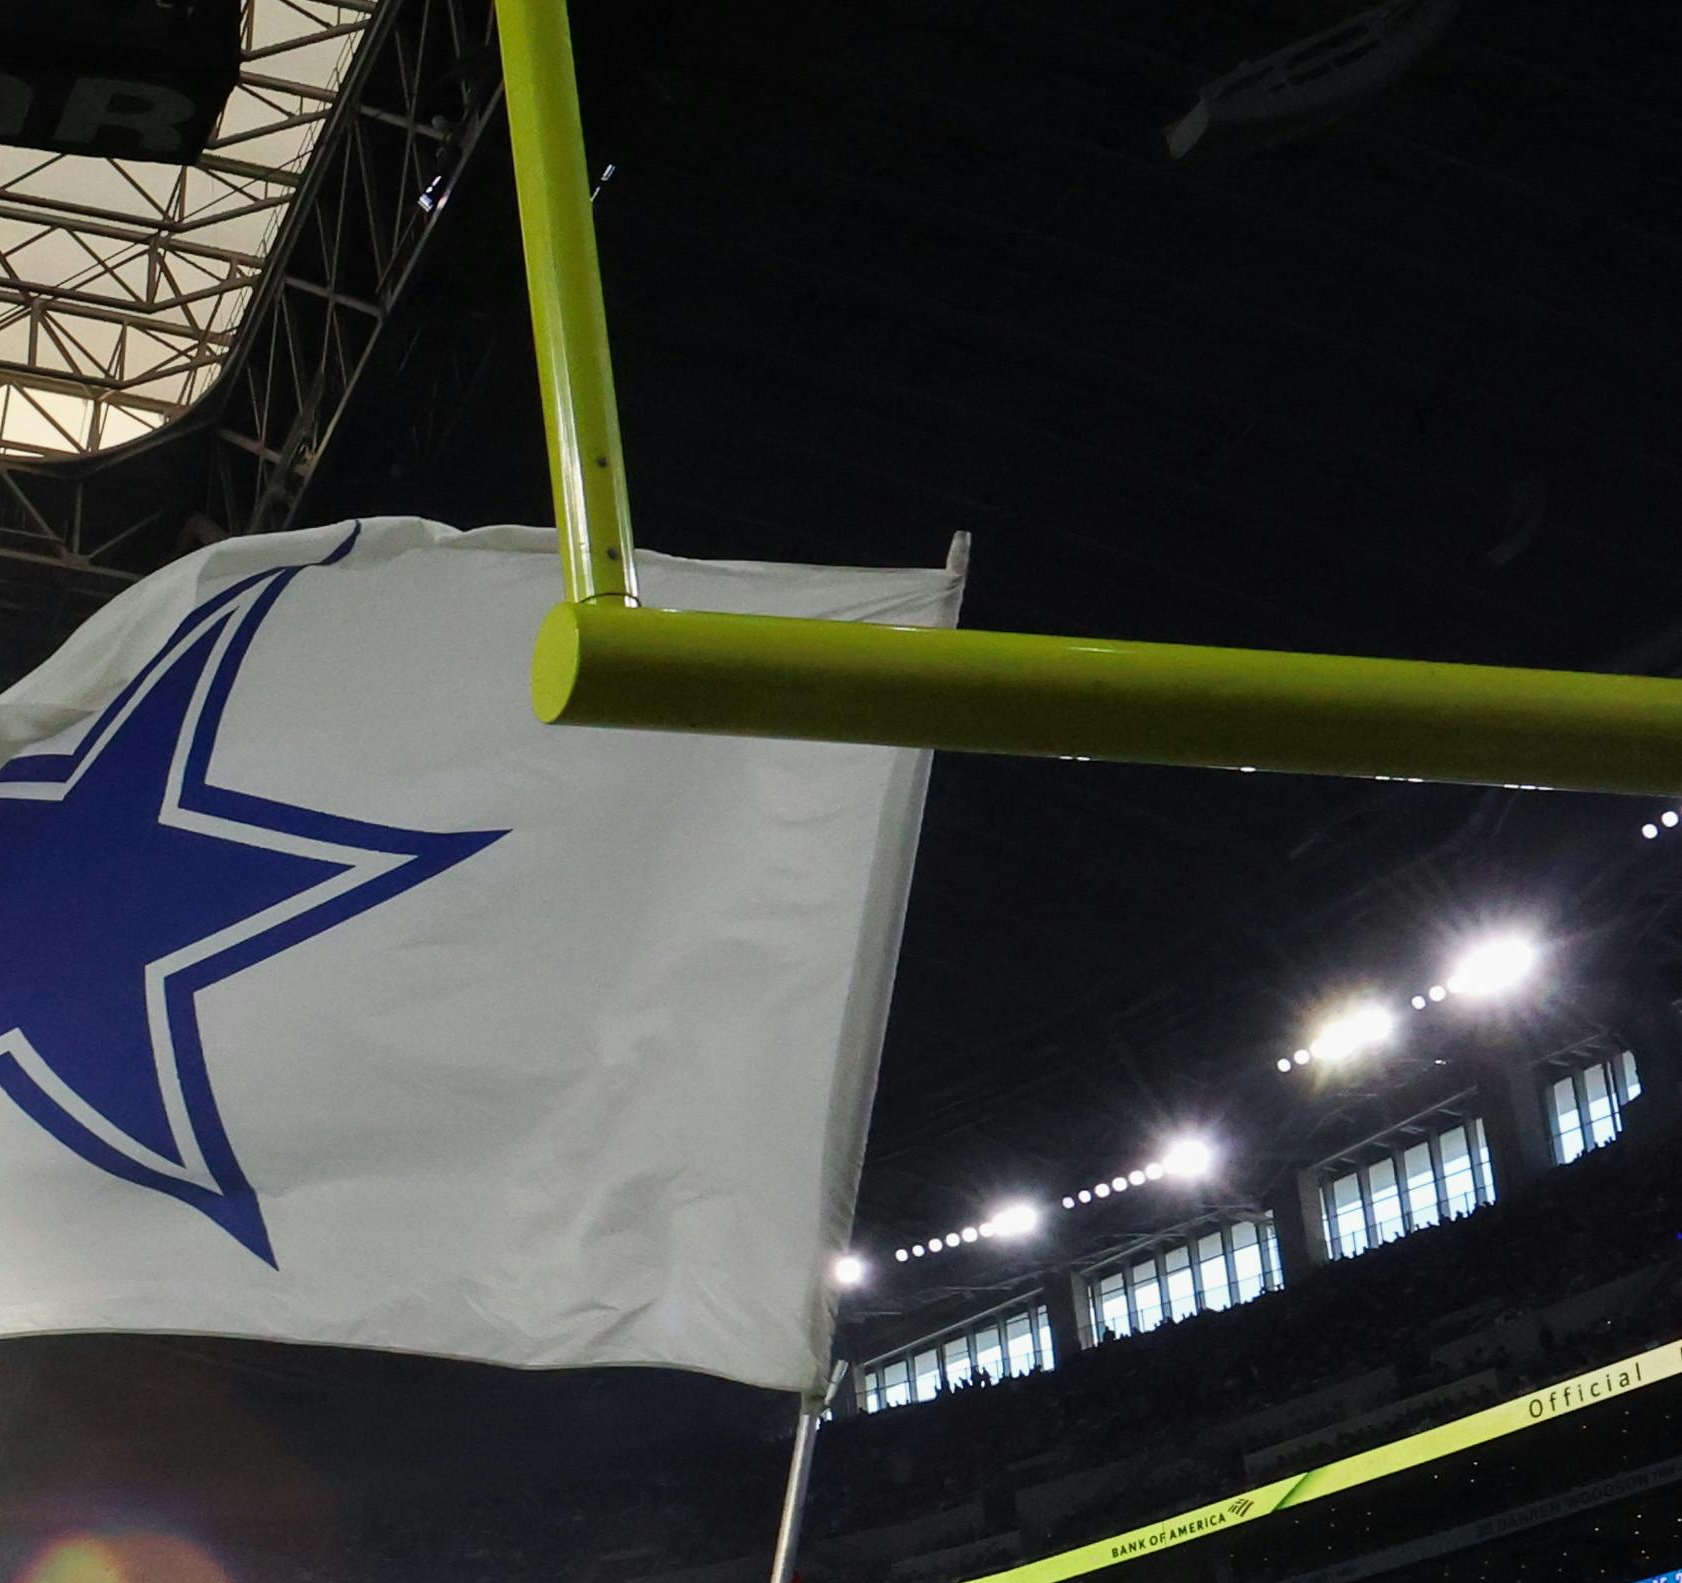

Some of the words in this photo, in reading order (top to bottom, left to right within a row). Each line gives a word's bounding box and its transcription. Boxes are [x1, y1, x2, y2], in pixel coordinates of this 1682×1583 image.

[1528, 1362, 1643, 1419] Official
[1111, 1540, 1147, 1559] BANK
[1148, 1532, 1166, 1546] OF
[1168, 1511, 1227, 1541] AMERICA
